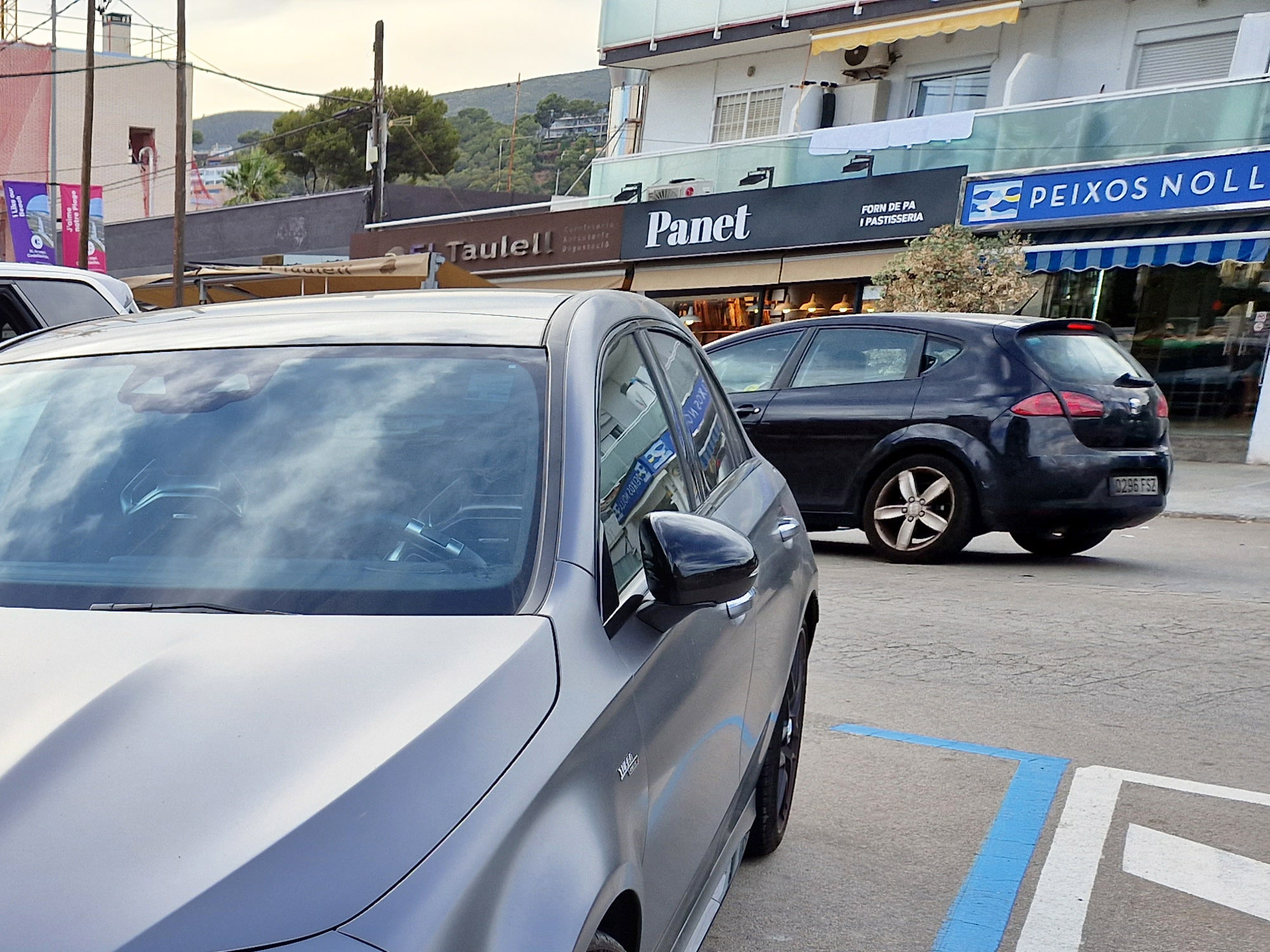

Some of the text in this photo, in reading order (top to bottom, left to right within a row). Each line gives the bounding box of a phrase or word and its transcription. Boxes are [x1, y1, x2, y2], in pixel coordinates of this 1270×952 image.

[1030, 165, 1265, 208] PEIXOS NOLL
[16, 195, 25, 217] Beach
[861, 200, 916, 214] FORN DE PA
[65, 207, 73, 232] J'aime
[645, 204, 752, 249] Panet
[859, 212, 924, 227] I PASTISSERIA
[445, 231, 553, 262] Taulell
